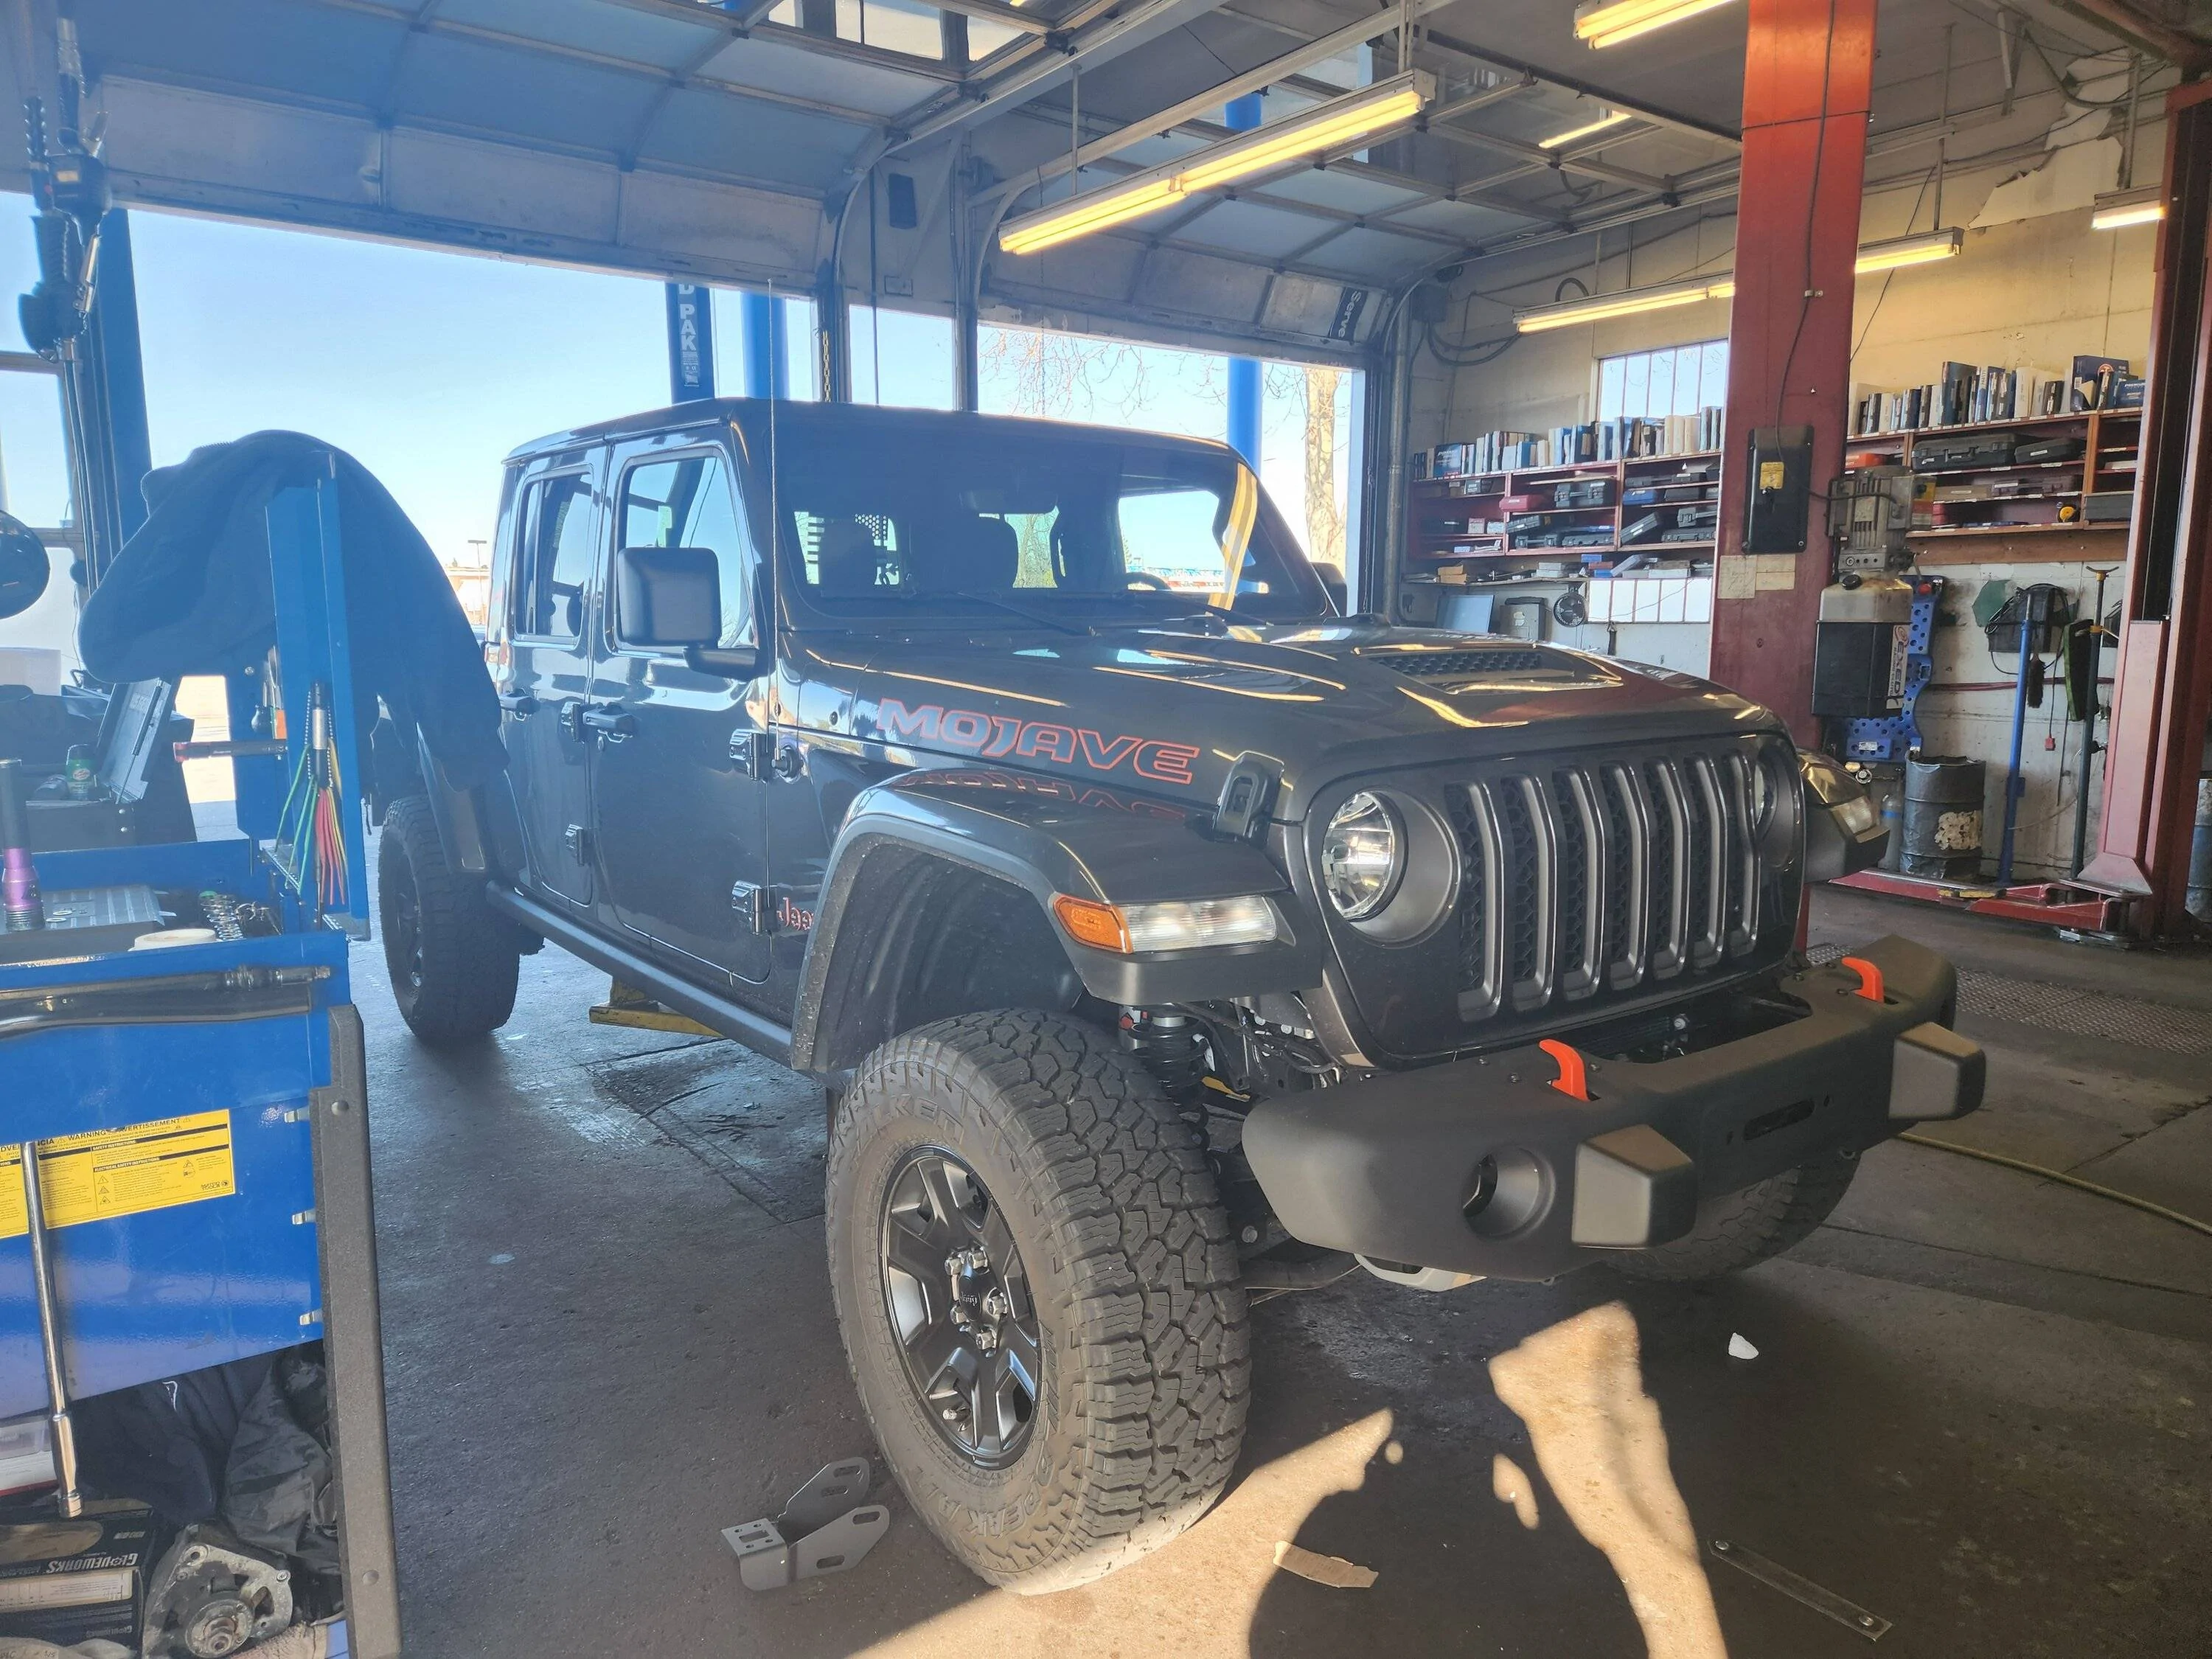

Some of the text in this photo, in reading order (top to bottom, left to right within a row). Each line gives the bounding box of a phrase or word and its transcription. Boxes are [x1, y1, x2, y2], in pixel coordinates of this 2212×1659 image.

[679, 304, 697, 351] PAK
[1338, 291, 1362, 338] Serve
[876, 698, 1200, 785] MOJAVE
[776, 897, 814, 931] Jee
[68, 1130, 106, 1141] WARNING
[119, 1118, 181, 1133] VERTISSEMENT
[46, 1553, 139, 1574] GLOVEWORKS
